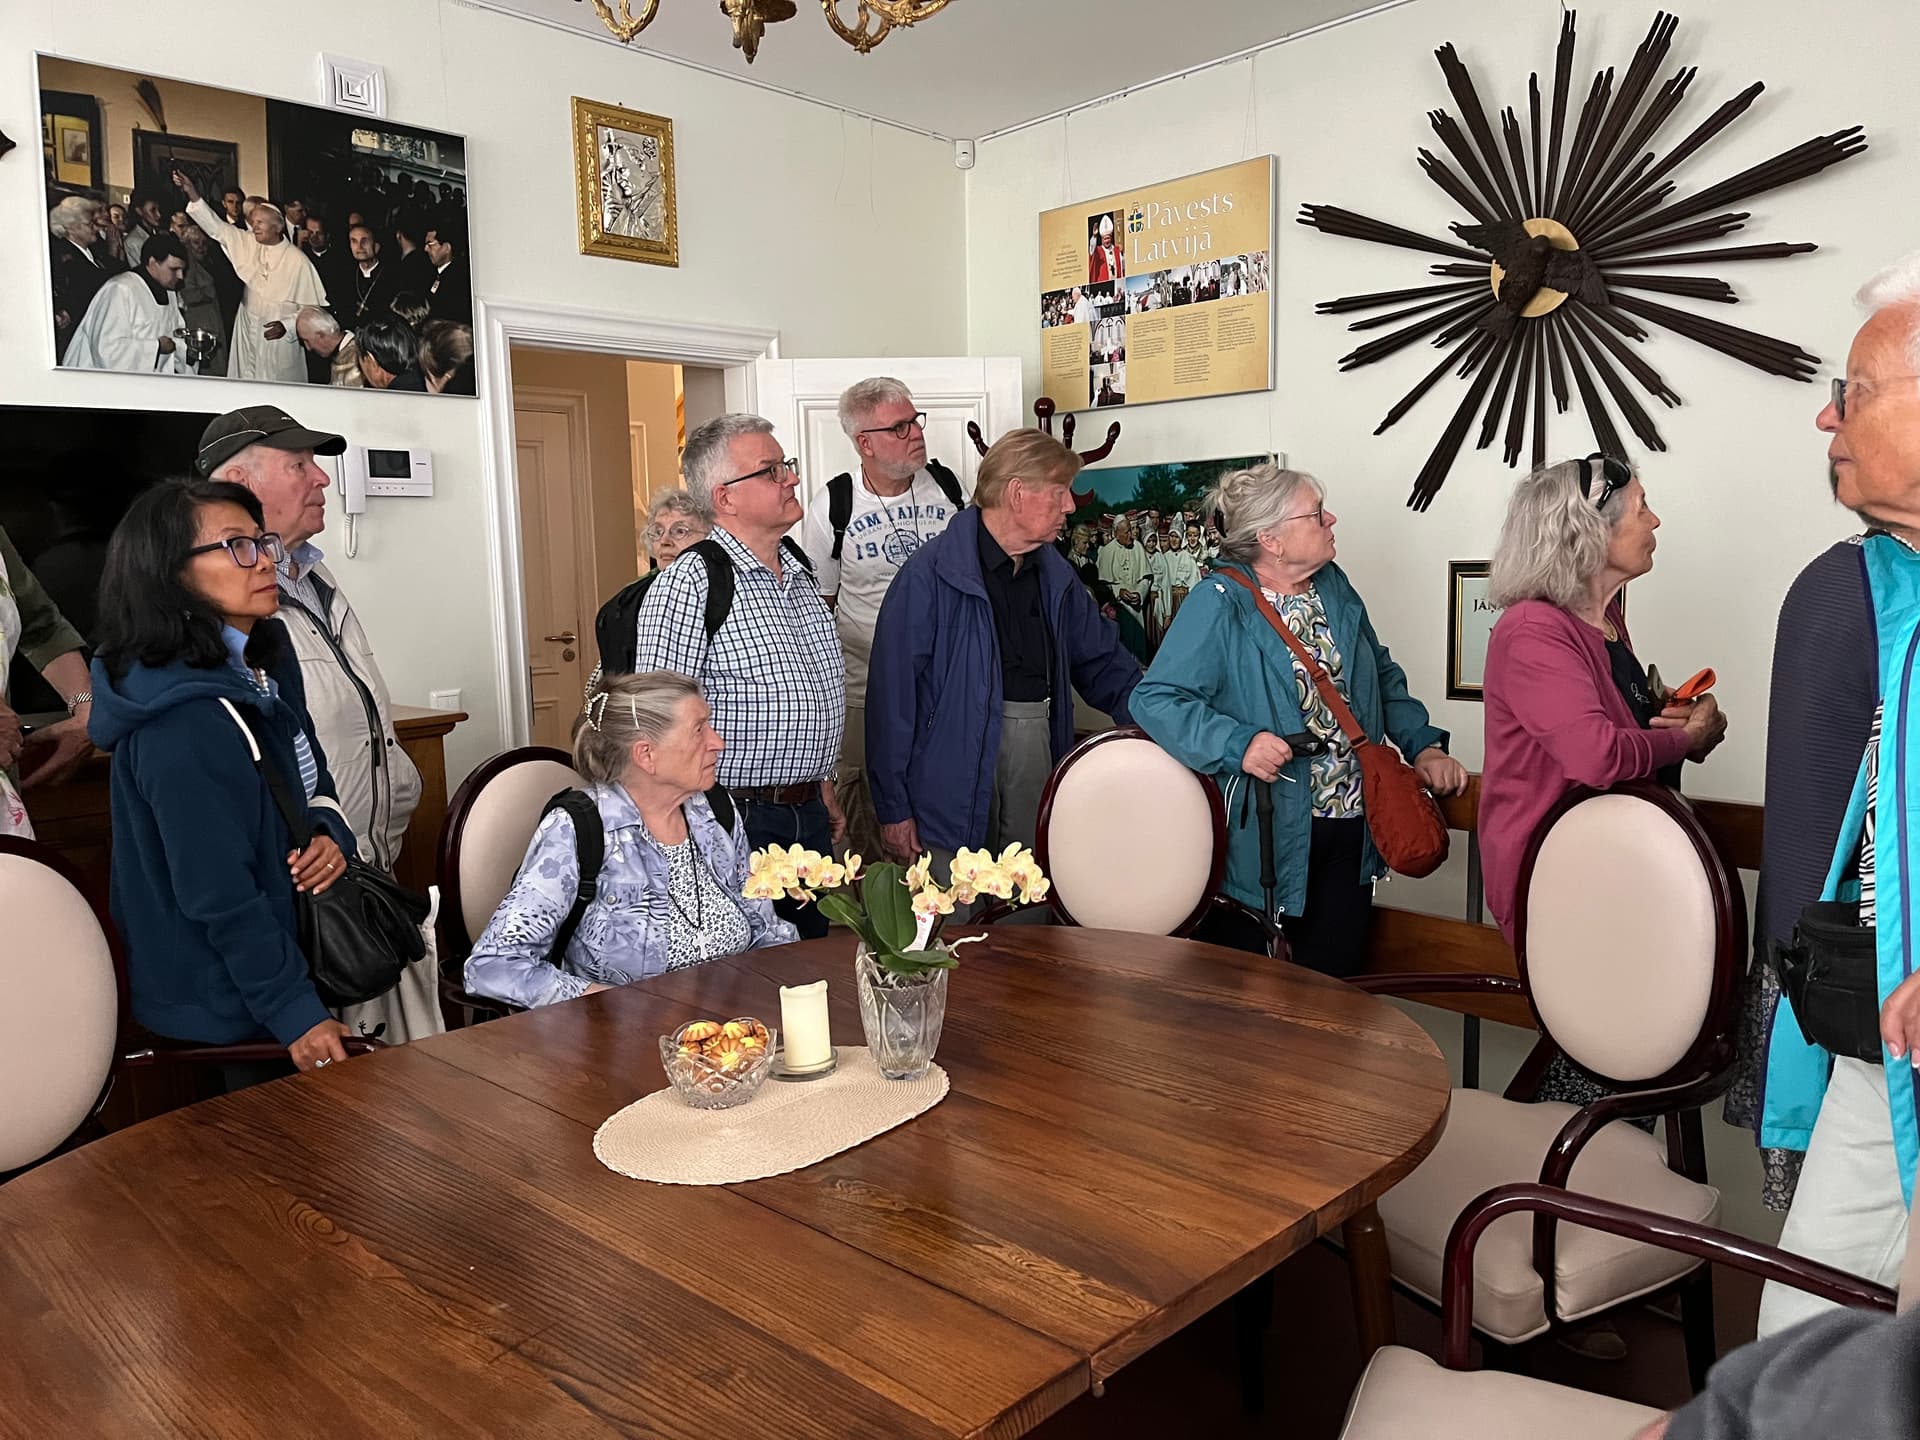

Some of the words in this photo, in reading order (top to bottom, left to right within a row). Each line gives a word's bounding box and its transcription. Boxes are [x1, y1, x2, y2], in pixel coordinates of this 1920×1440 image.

[1145, 192, 1233, 229] Pāvests
[1134, 225, 1212, 264] Latvijā
[1473, 598, 1504, 613] JĀŅ
